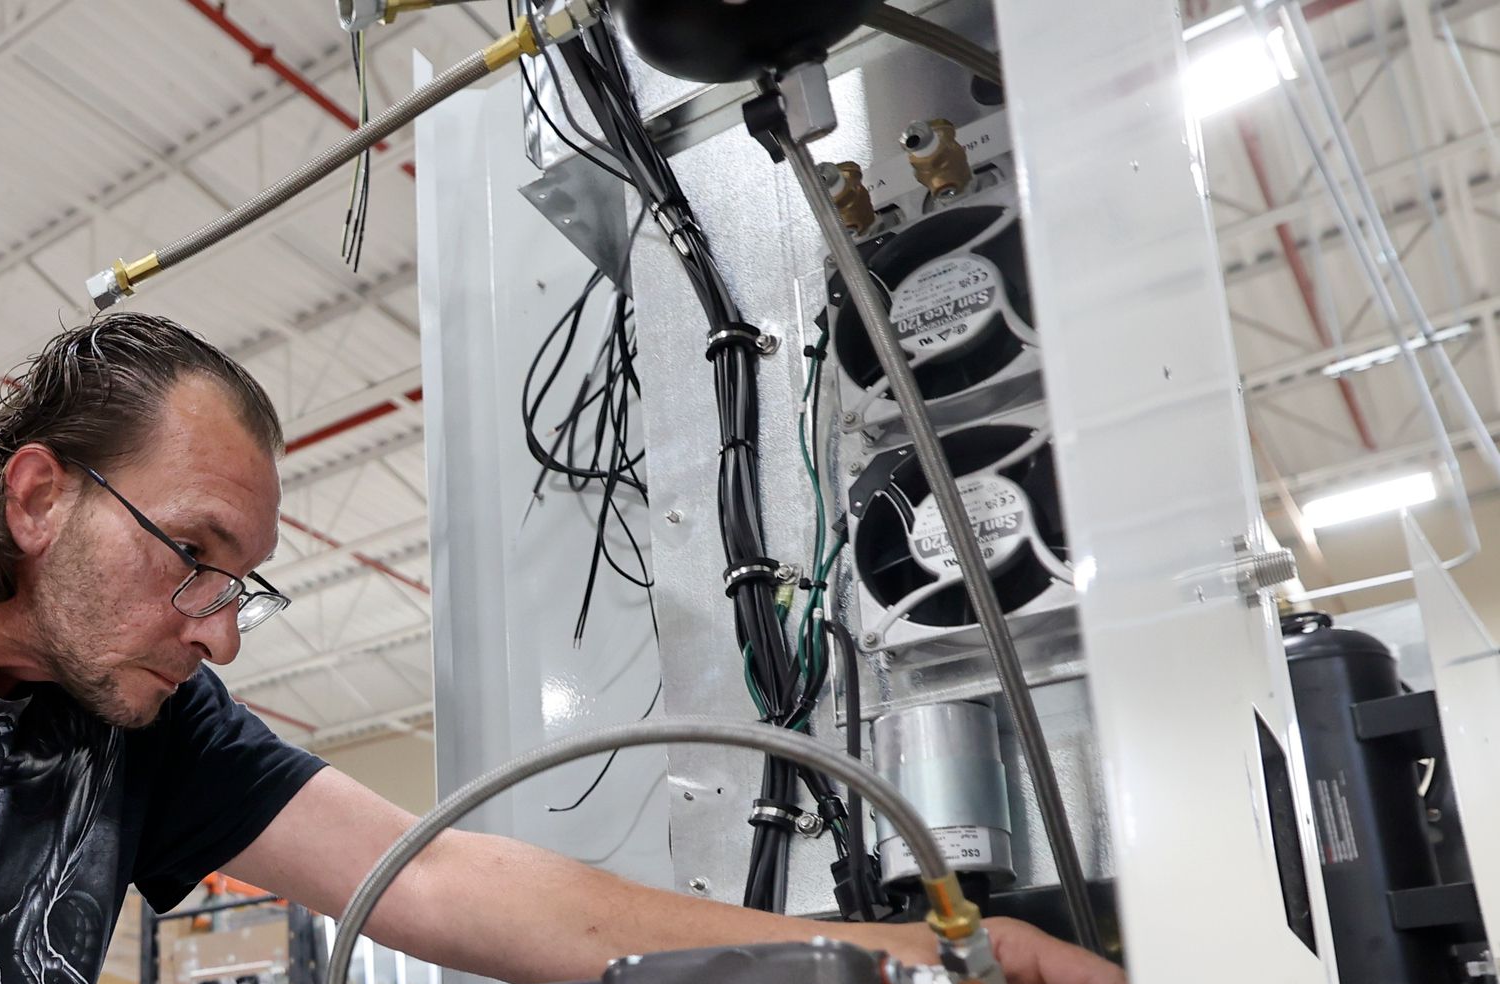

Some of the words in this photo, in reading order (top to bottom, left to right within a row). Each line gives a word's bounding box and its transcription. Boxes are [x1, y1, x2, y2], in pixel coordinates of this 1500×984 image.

[958, 289, 989, 308] San
[924, 302, 956, 320] Ace
[898, 315, 923, 334] 120
[984, 514, 1018, 531] San
[921, 535, 949, 552] 120
[961, 848, 981, 857] CSC
